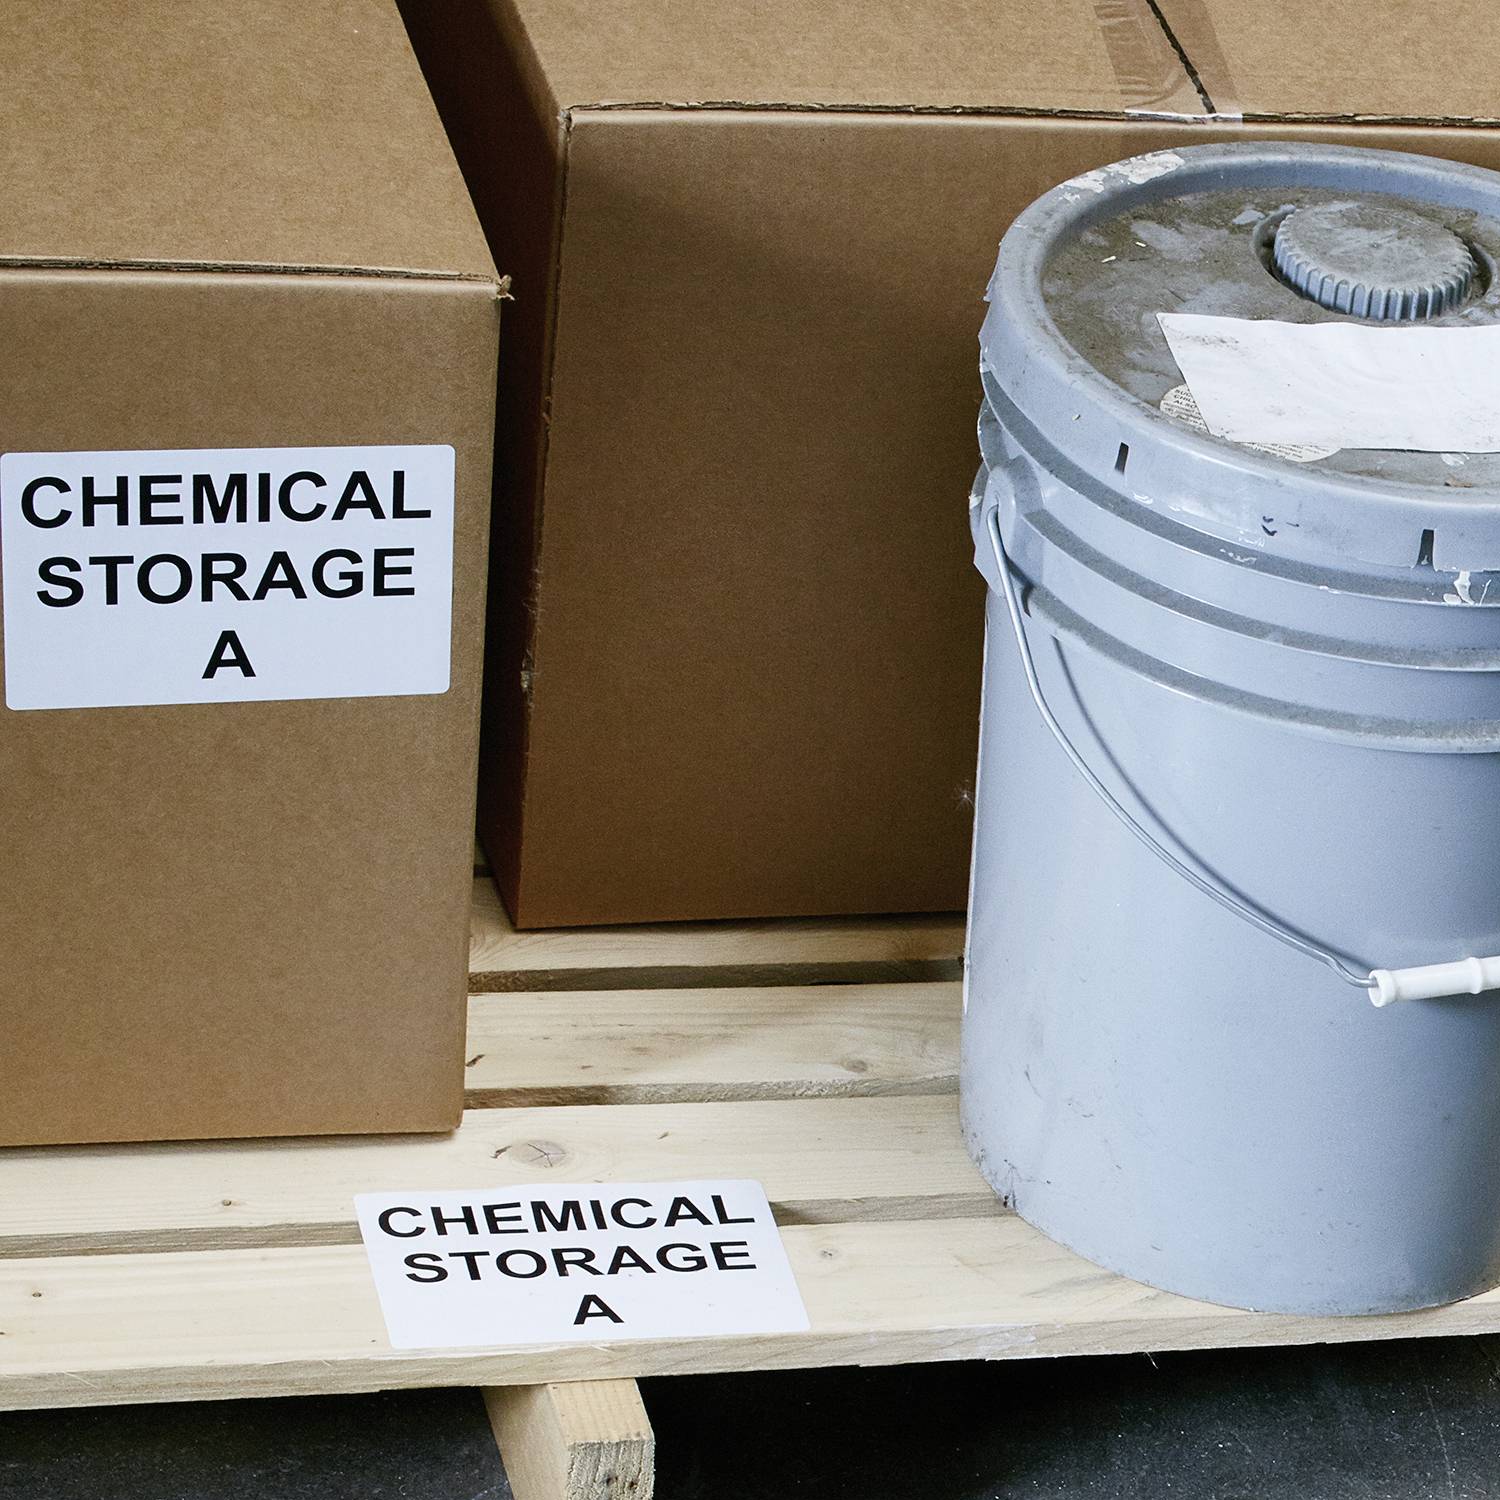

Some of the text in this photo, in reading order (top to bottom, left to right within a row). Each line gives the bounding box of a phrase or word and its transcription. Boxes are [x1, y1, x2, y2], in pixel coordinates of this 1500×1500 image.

[21, 470, 432, 528] CHEMICAL
[36, 547, 415, 607] STORAGE
[202, 630, 256, 679] A
[378, 1195, 756, 1238] CHEMICAL
[403, 1241, 757, 1283] STORAGE
[573, 1294, 625, 1325] A
